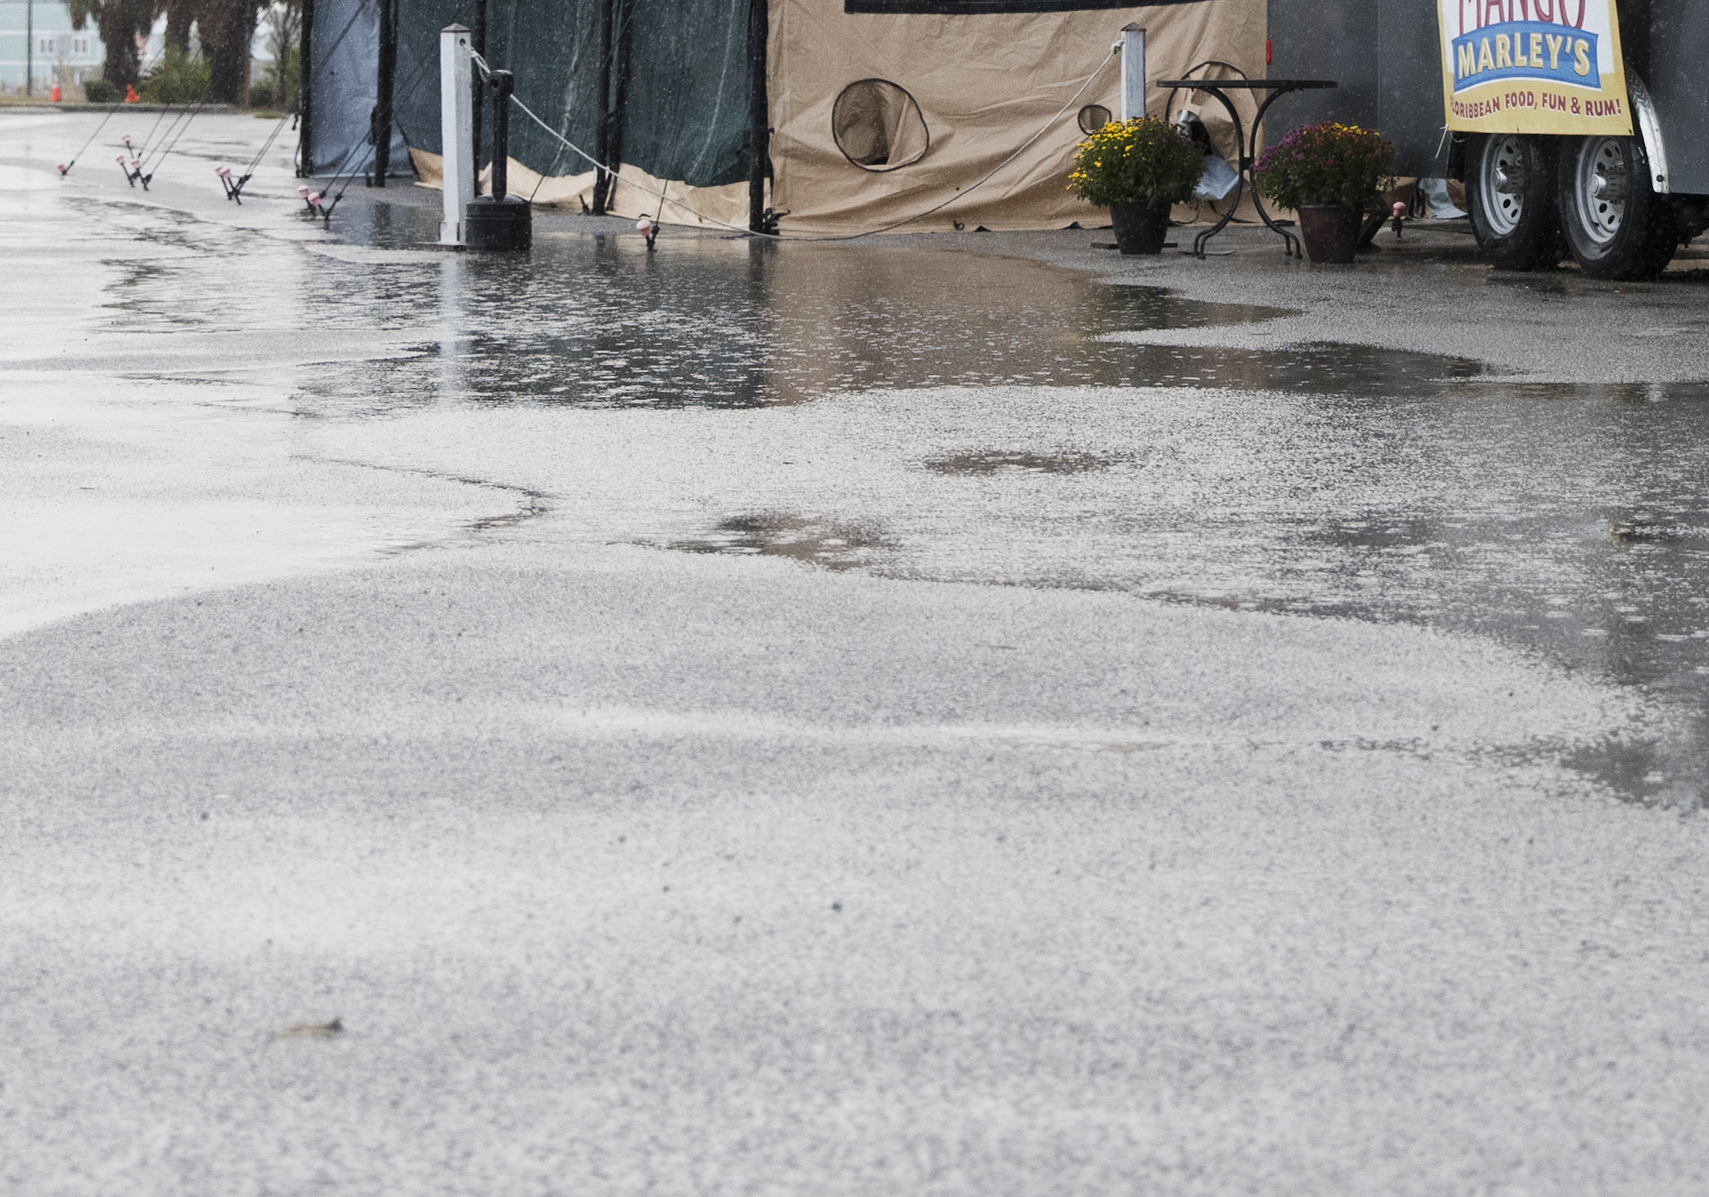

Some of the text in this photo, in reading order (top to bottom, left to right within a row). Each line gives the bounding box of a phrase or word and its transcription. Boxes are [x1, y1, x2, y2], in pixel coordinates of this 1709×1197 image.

[1457, 32, 1591, 77] MARLEY'S
[1505, 91, 1538, 111] FOOD,
[1542, 92, 1566, 112] FUN
[1571, 97, 1581, 115] &
[1585, 98, 1622, 117] RUM!
